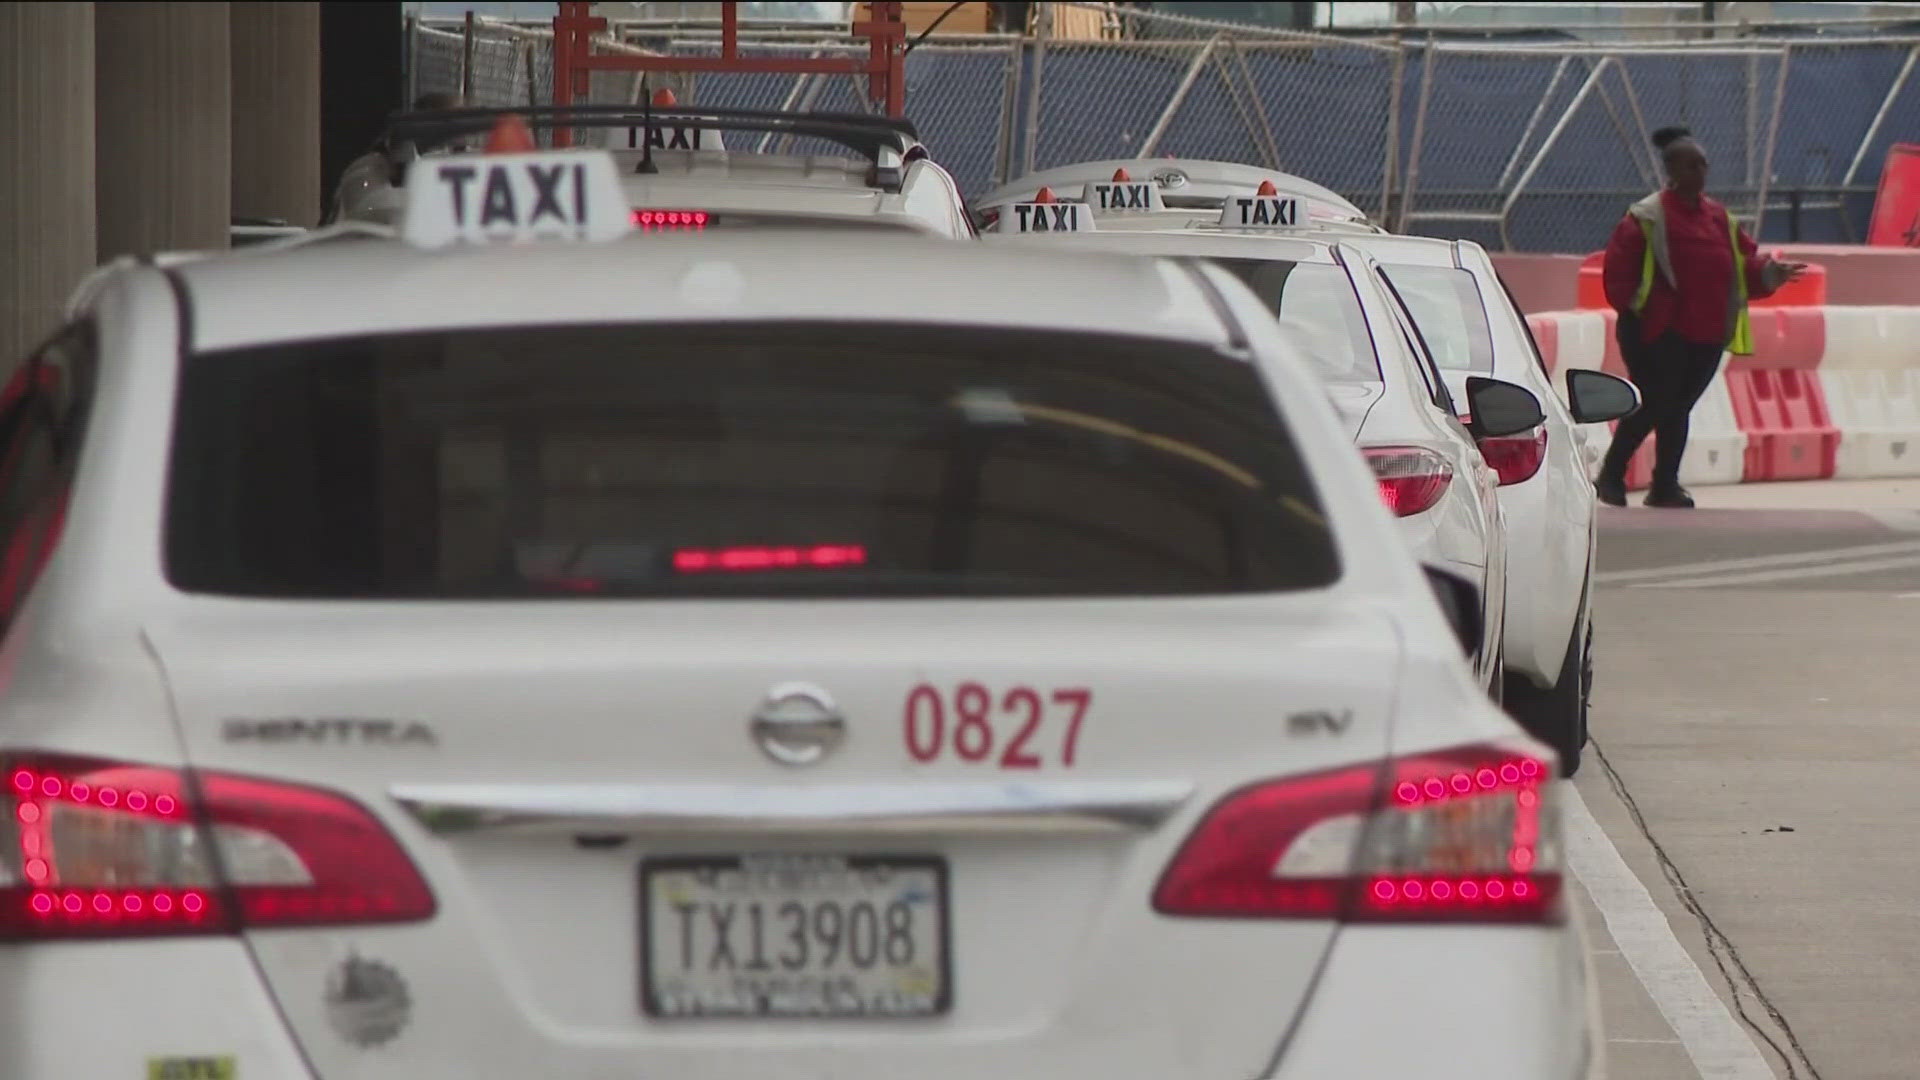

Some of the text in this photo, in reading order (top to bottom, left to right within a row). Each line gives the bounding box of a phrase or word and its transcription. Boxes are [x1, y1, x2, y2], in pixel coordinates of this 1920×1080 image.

[623, 114, 702, 150] TAXI
[438, 163, 588, 228] TAXI
[1096, 184, 1151, 209] TAXI
[1236, 198, 1296, 226] TAXI
[1014, 204, 1078, 233] TAXI
[904, 682, 1092, 770] 0827
[673, 900, 915, 971] TX13908
